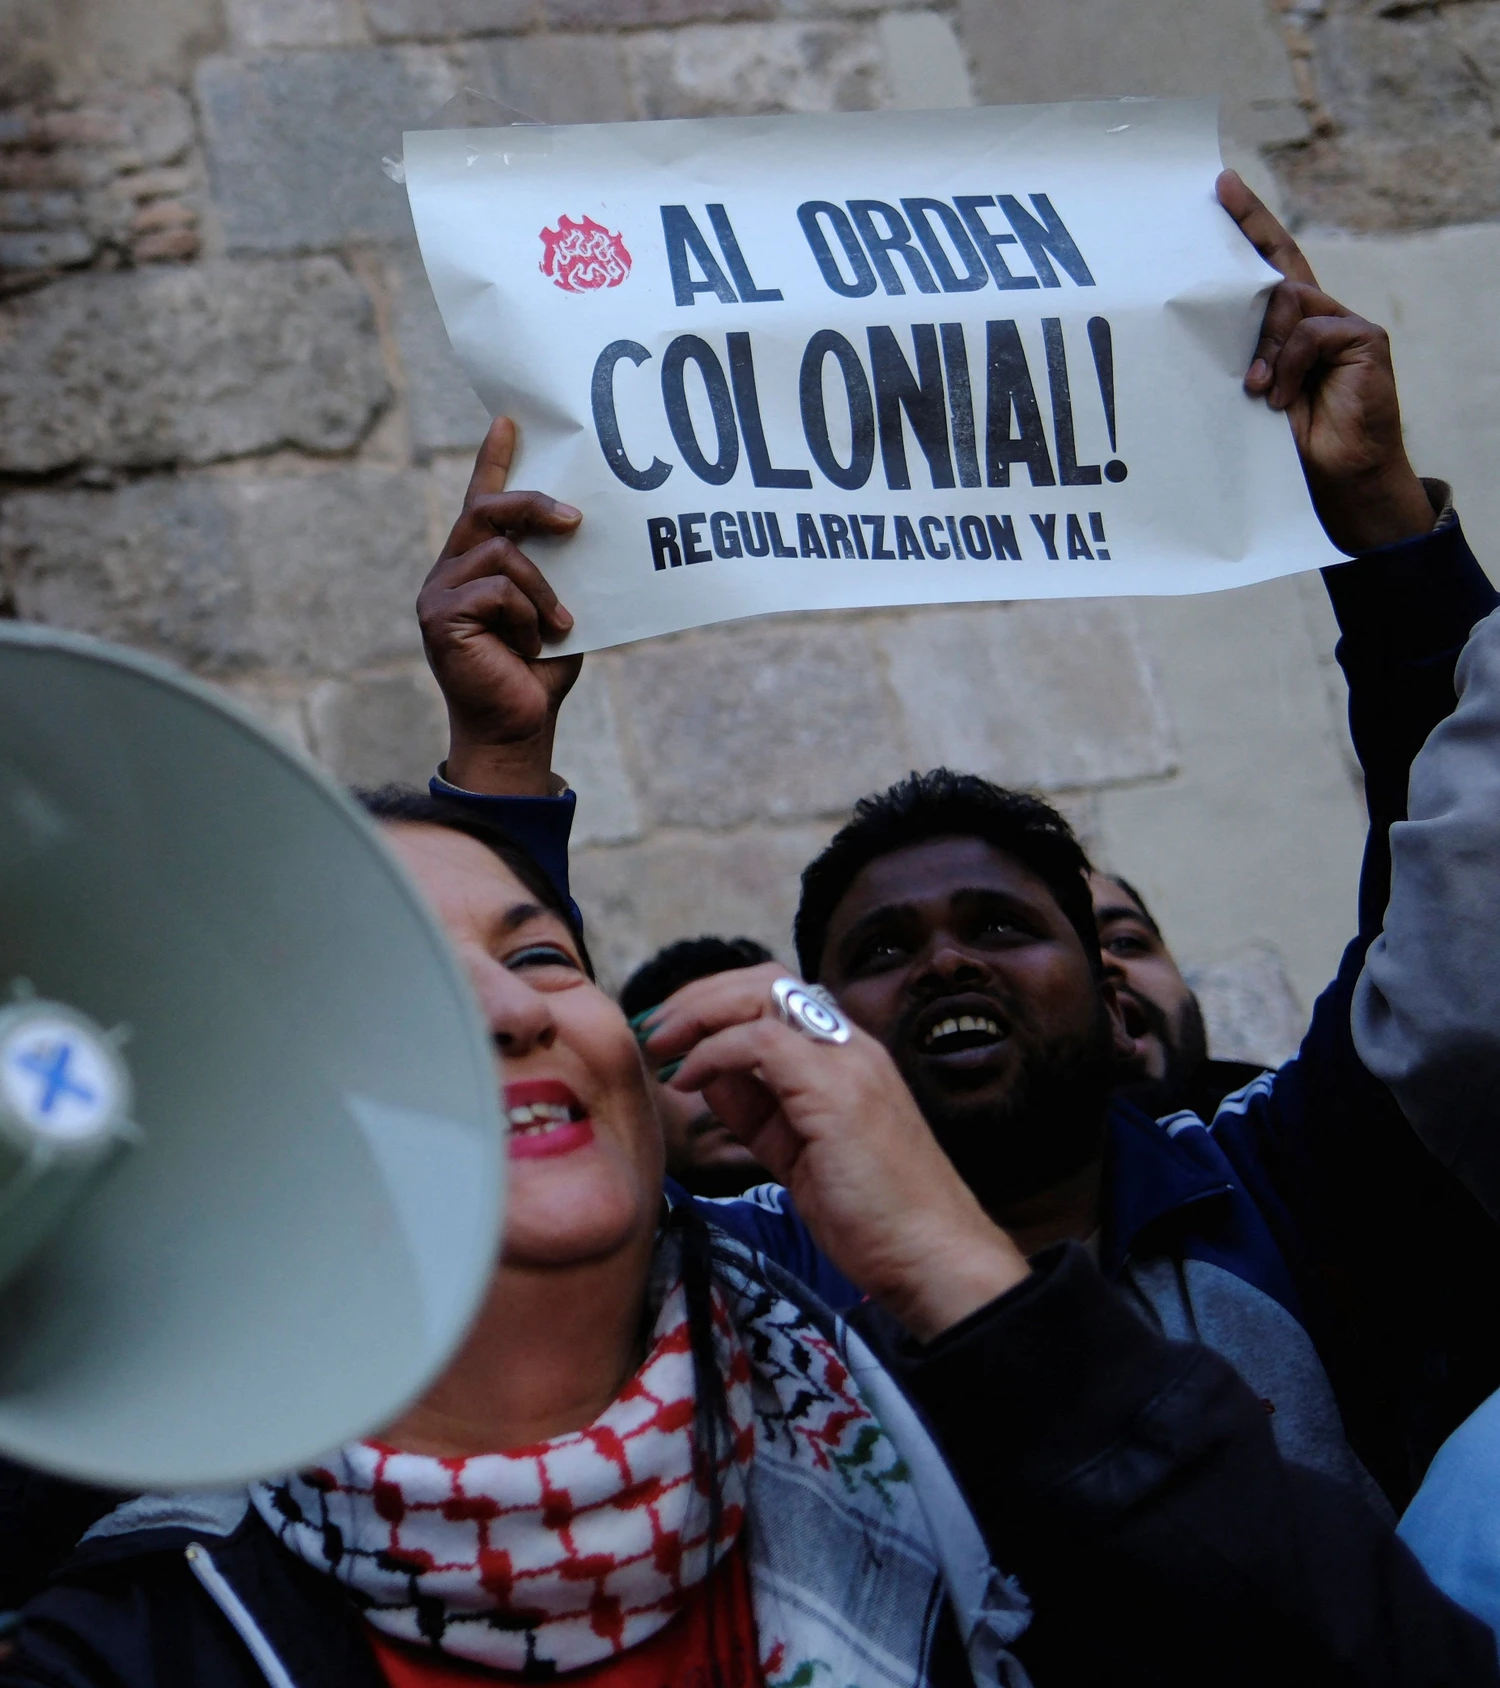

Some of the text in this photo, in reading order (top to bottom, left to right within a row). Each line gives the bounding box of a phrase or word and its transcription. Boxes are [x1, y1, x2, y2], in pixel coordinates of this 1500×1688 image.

[660, 193, 1096, 307] AL ORDEN
[591, 316, 1128, 491] COLONIAL!
[646, 511, 1111, 572] REGULARIZACION YA!
